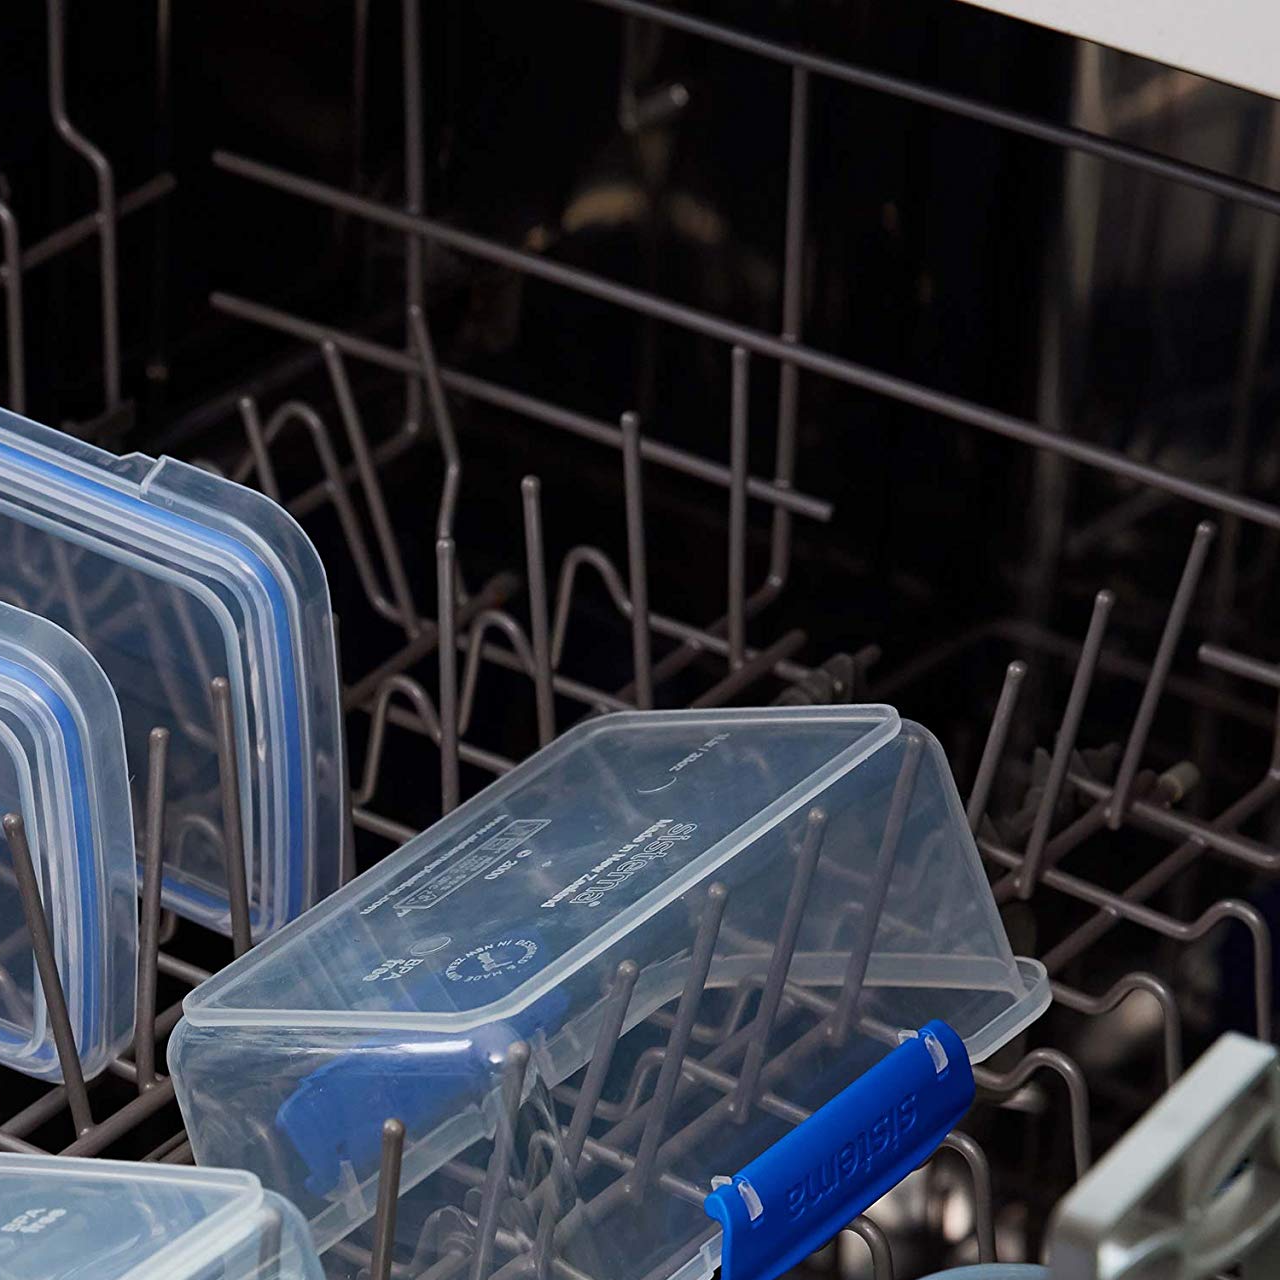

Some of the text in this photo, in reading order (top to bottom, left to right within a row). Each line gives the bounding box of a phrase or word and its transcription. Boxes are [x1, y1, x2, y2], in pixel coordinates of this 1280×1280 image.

[570, 823, 697, 905] sistema
[382, 959, 424, 981] BPA
[788, 1095, 917, 1220] sistema
